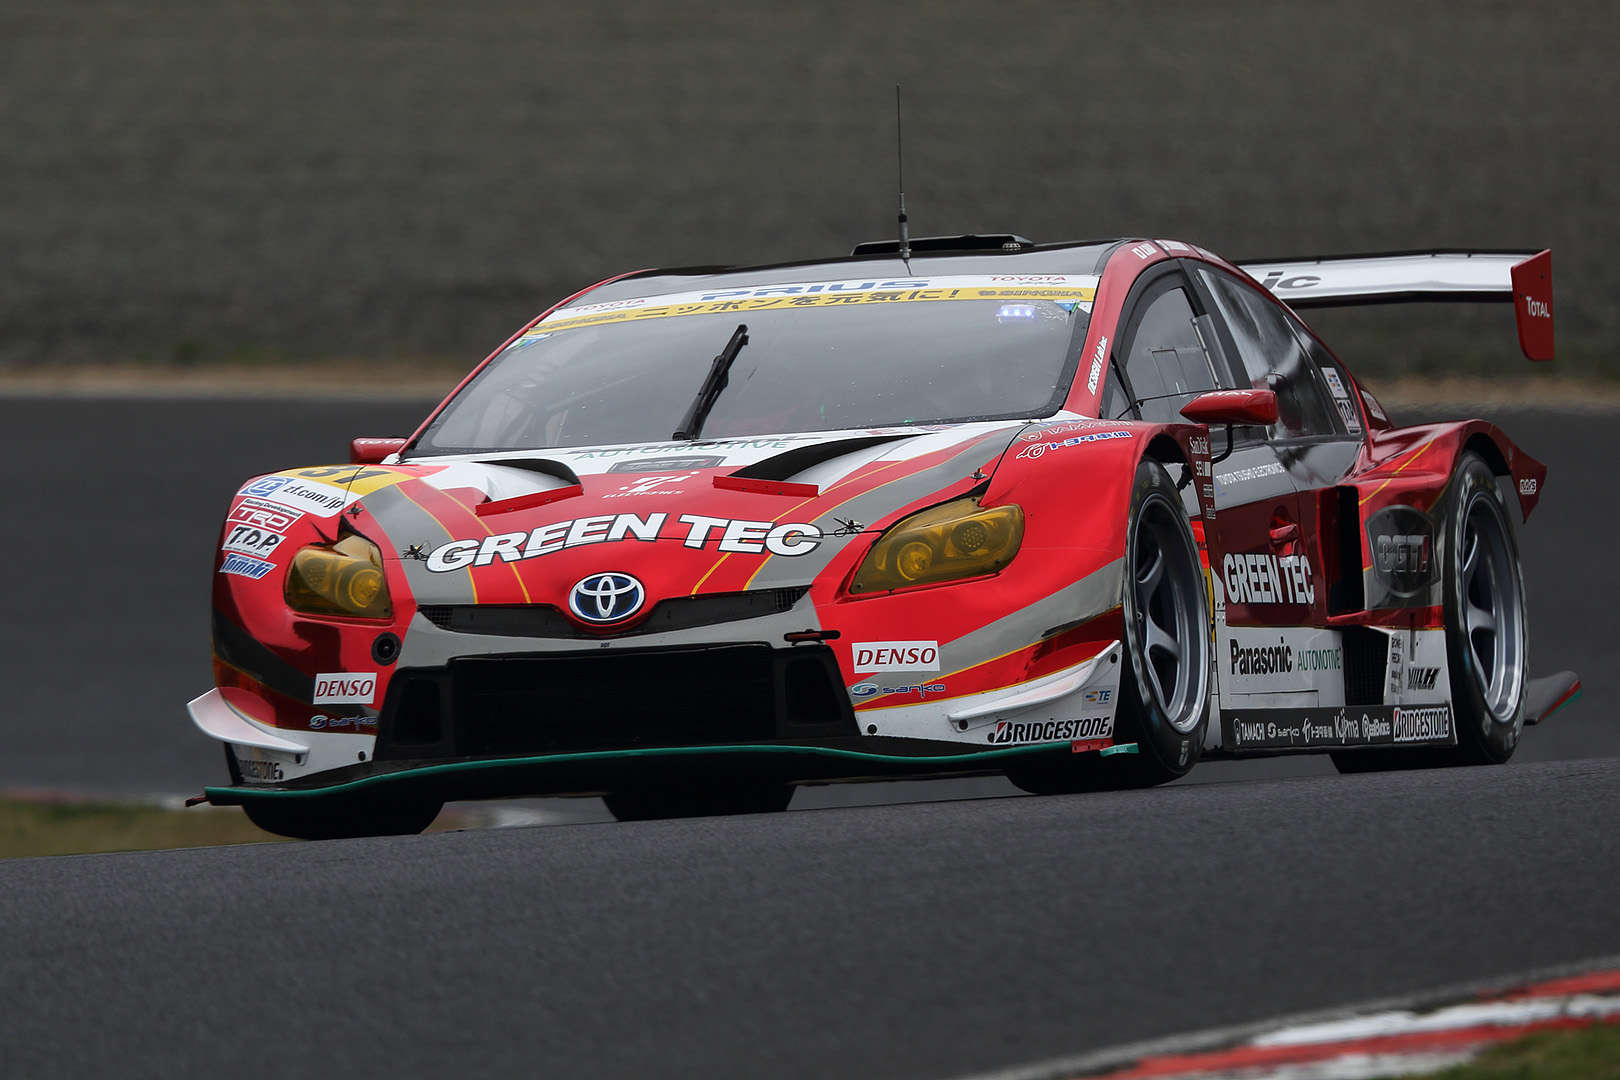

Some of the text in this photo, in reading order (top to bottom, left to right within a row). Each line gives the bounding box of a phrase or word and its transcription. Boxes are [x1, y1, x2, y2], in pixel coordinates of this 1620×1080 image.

[700, 279, 930, 301] PRIUS
[574, 299, 645, 313] TOYOTA
[1526, 296, 1550, 318] TOTAL
[574, 441, 790, 461] AUTOMOTIVE
[283, 485, 345, 510] zf.com/jp
[238, 506, 289, 527] TRD
[426, 512, 824, 574] GREEN TEC
[1223, 552, 1316, 605] GREEN TEC
[856, 647, 937, 667] DENSO
[1229, 636, 1293, 676] Panasonic
[1297, 648, 1342, 671] AUTOMOTIVE
[315, 679, 374, 698] DENSO
[882, 683, 947, 699] sanko
[1098, 690, 1112, 702] TE
[329, 715, 378, 731] sanko
[987, 715, 1113, 744] BRIDGESTONE
[1241, 722, 1266, 741] TAMACHI
[1393, 707, 1450, 741] BRIDGESTONE
[1277, 726, 1300, 745] sanko
